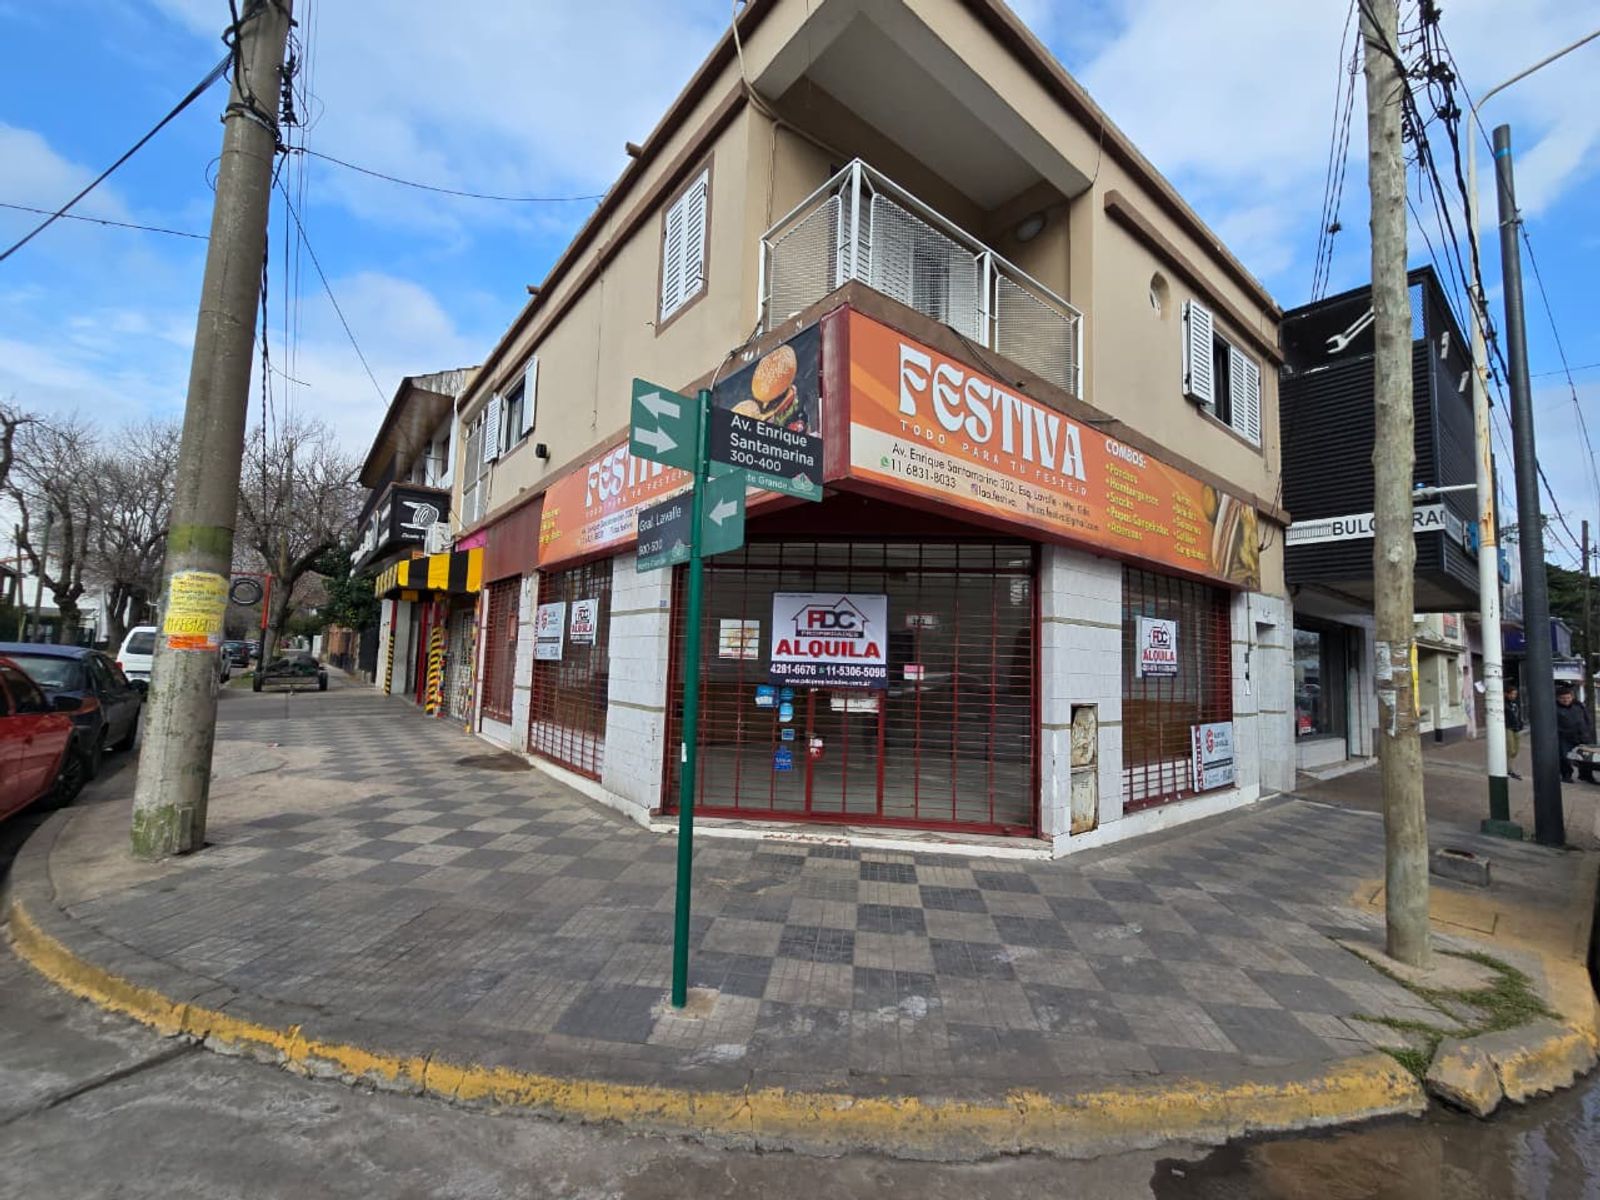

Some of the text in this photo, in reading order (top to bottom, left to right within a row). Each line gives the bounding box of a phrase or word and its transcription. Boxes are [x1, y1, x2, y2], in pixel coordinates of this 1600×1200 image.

[899, 342, 1088, 482] FESTIVA
[731, 414, 807, 447] Av. Enrique
[730, 432, 814, 467] Santamarina
[730, 450, 782, 473] 300-400
[901, 420, 1088, 496] TODO PARA TU FESTEJO
[893, 443, 907, 459] Av.
[910, 448, 945, 470] Enrique
[948, 461, 999, 488] Santamarina
[906, 462, 957, 489] 6831-8033
[759, 476, 788, 489] Grande
[807, 610, 856, 629] PDC
[776, 639, 881, 659] ALQUILA
[1142, 648, 1175, 662] ALQUILA
[770, 663, 887, 678] 4281-6676 11-5306-5098
